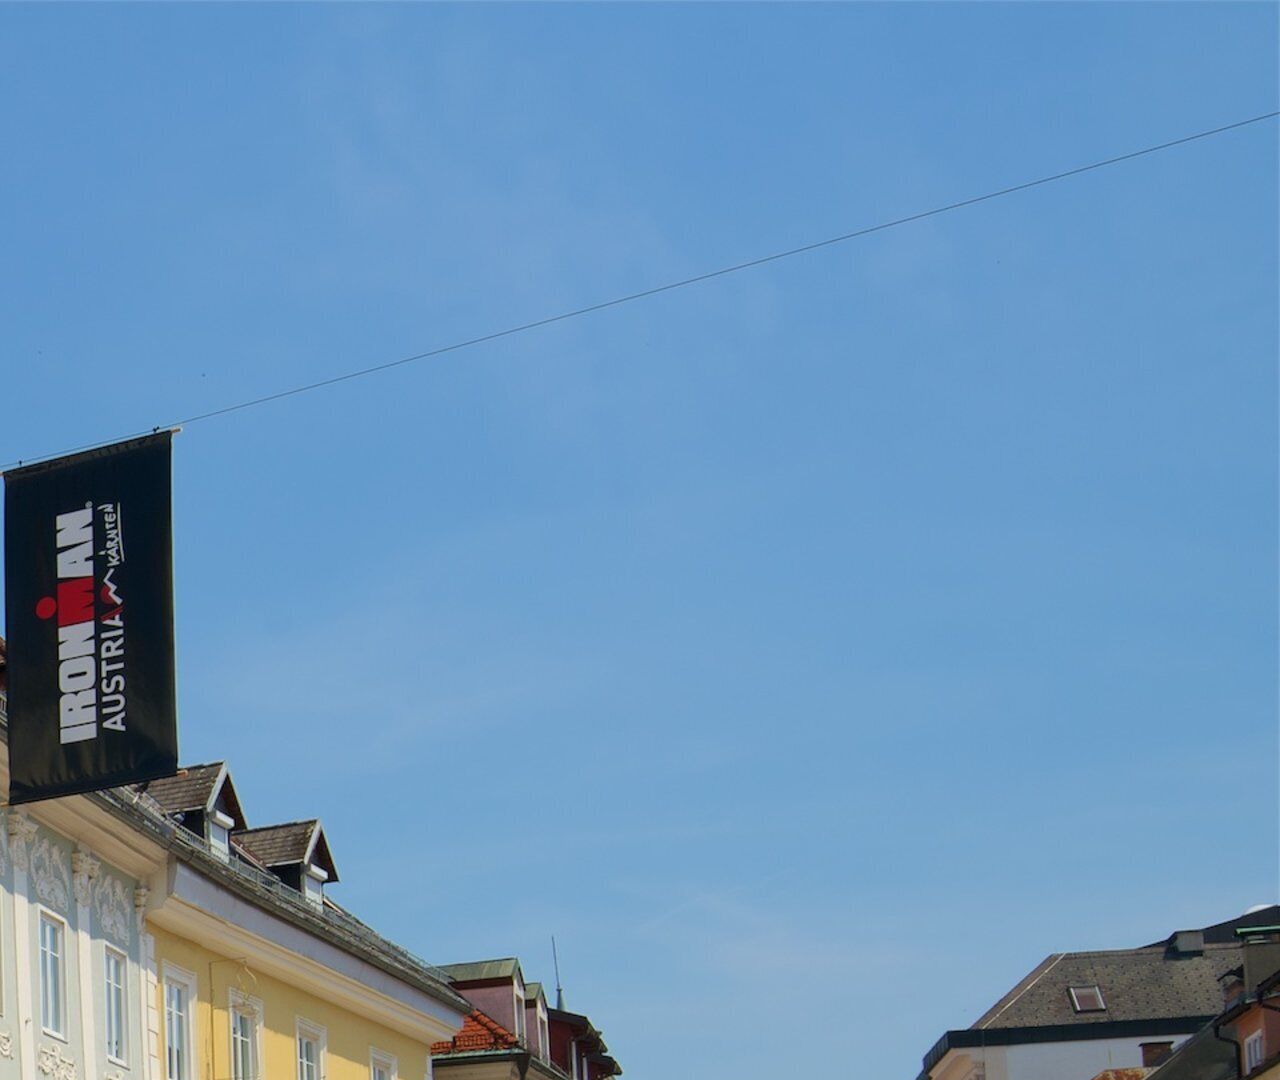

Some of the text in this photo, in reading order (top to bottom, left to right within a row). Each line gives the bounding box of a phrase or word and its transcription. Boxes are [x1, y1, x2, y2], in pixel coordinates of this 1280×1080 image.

[56, 509, 97, 744] IRONMAN
[98, 502, 127, 732] AUSTRIA KÄRNTEN
